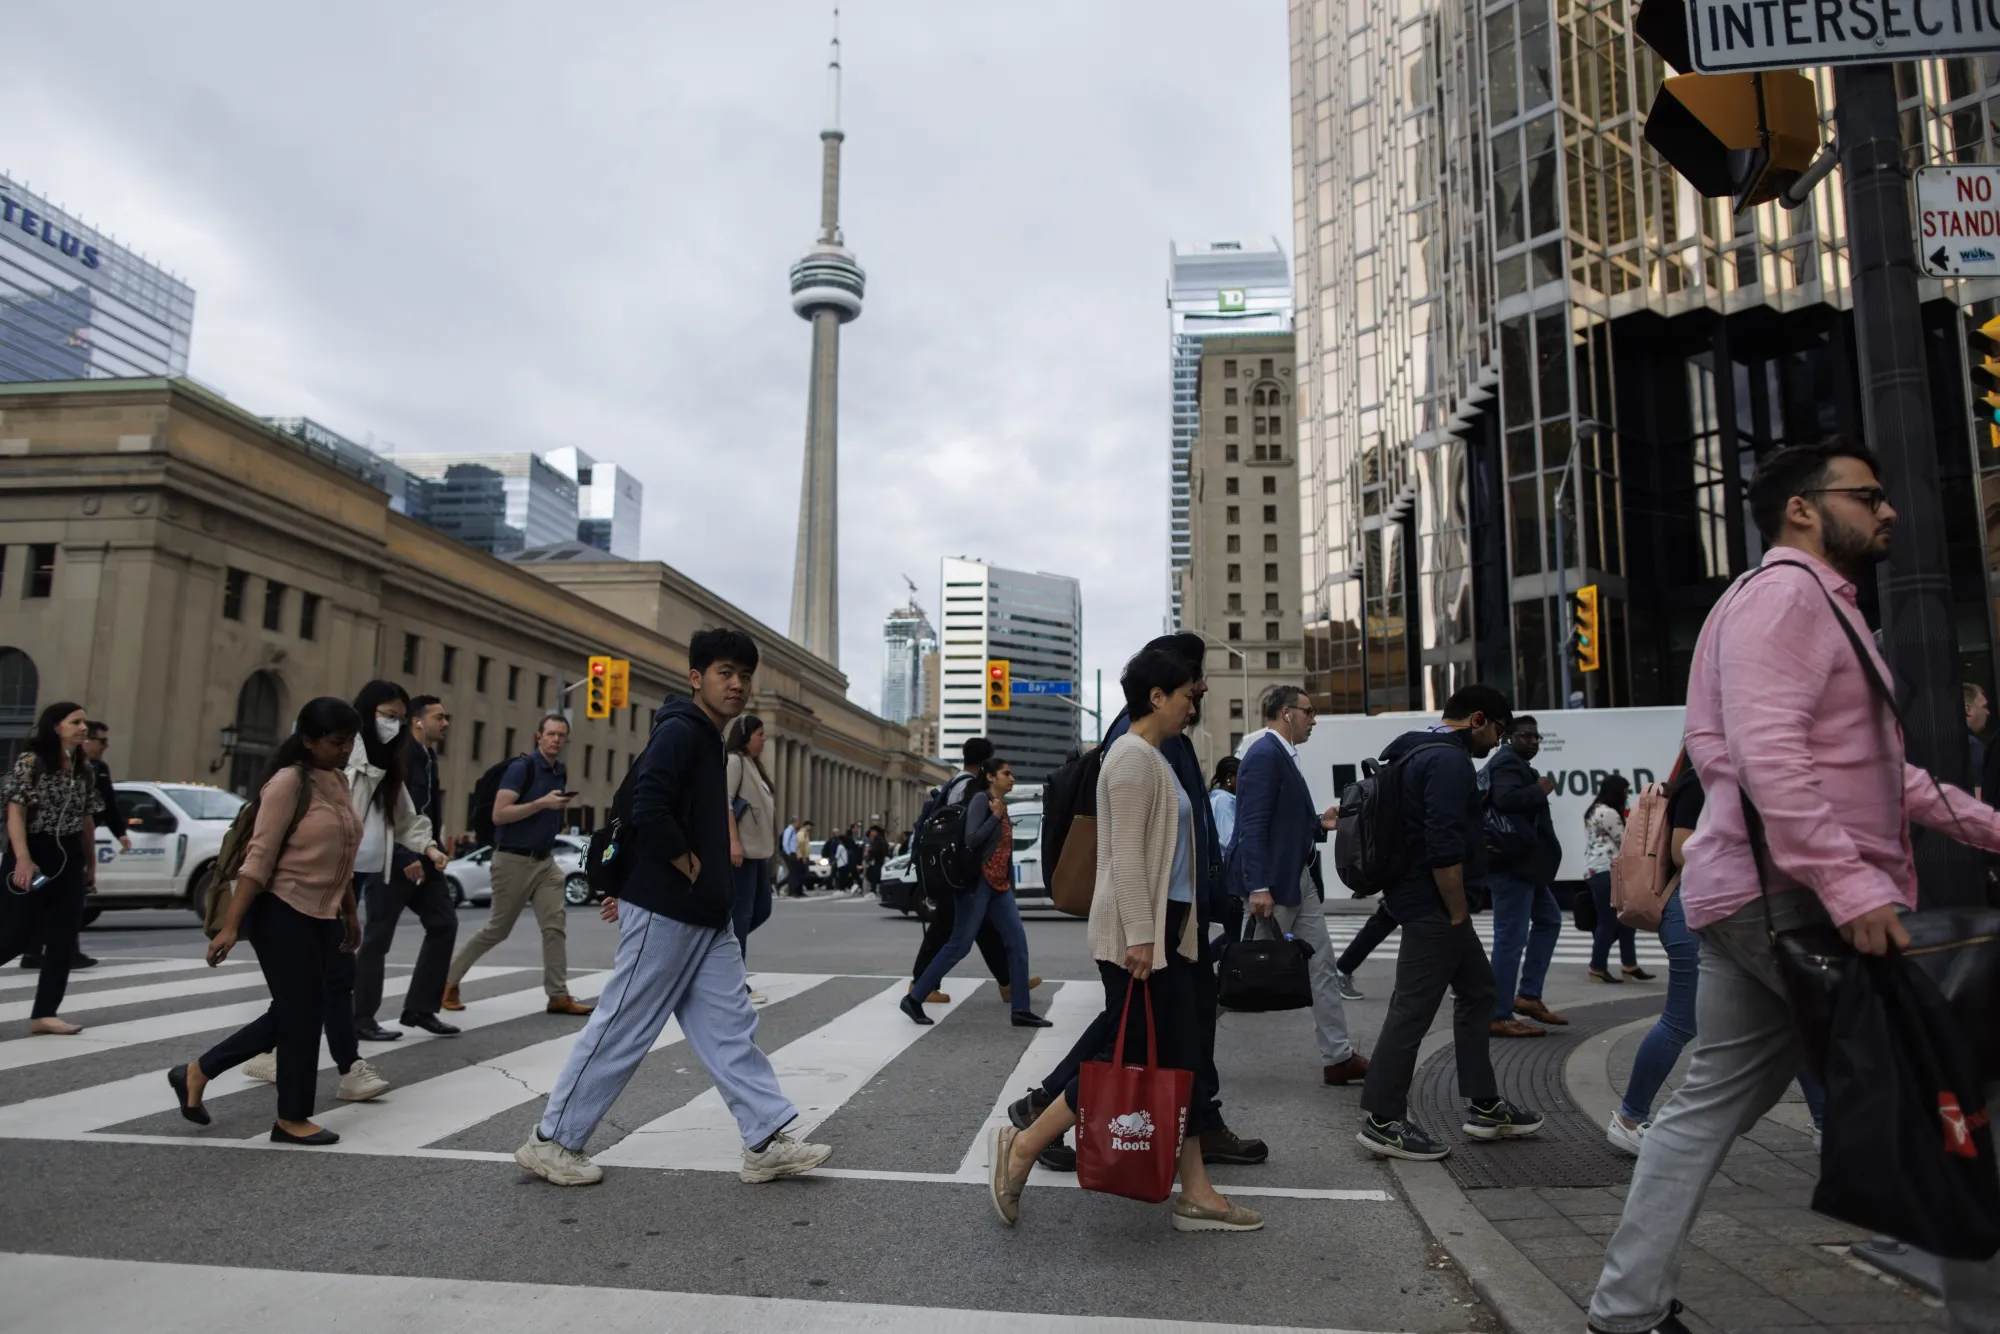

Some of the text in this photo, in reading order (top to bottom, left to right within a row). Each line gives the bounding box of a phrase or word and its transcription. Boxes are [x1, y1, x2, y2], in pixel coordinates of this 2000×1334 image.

[1957, 175, 1992, 203] NO
[1, 195, 100, 270] TELUS
[1220, 290, 1244, 307] TD
[1028, 681, 1047, 695] Bay
[1175, 1107, 1187, 1158] Roots
[1112, 1137, 1151, 1151] Roots
